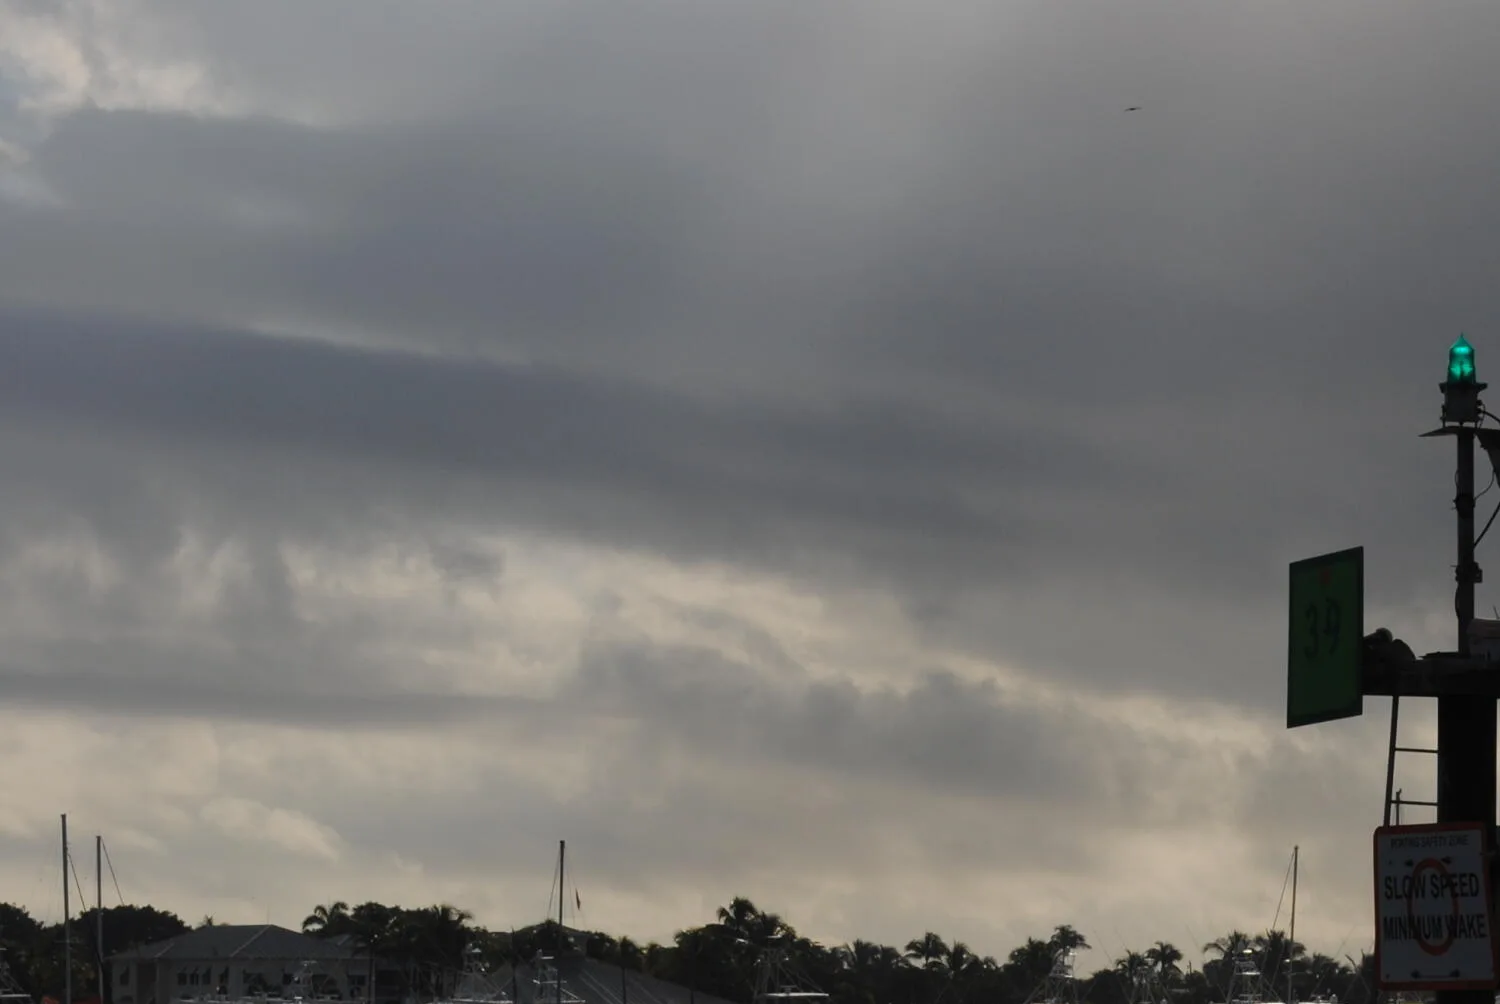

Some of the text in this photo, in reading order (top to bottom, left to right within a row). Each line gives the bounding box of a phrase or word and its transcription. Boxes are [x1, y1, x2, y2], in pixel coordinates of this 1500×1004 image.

[1304, 597, 1341, 659] 39
[1384, 873, 1480, 899] SLOW SPEED
[1383, 914, 1488, 941] MINIMUM WAKE
